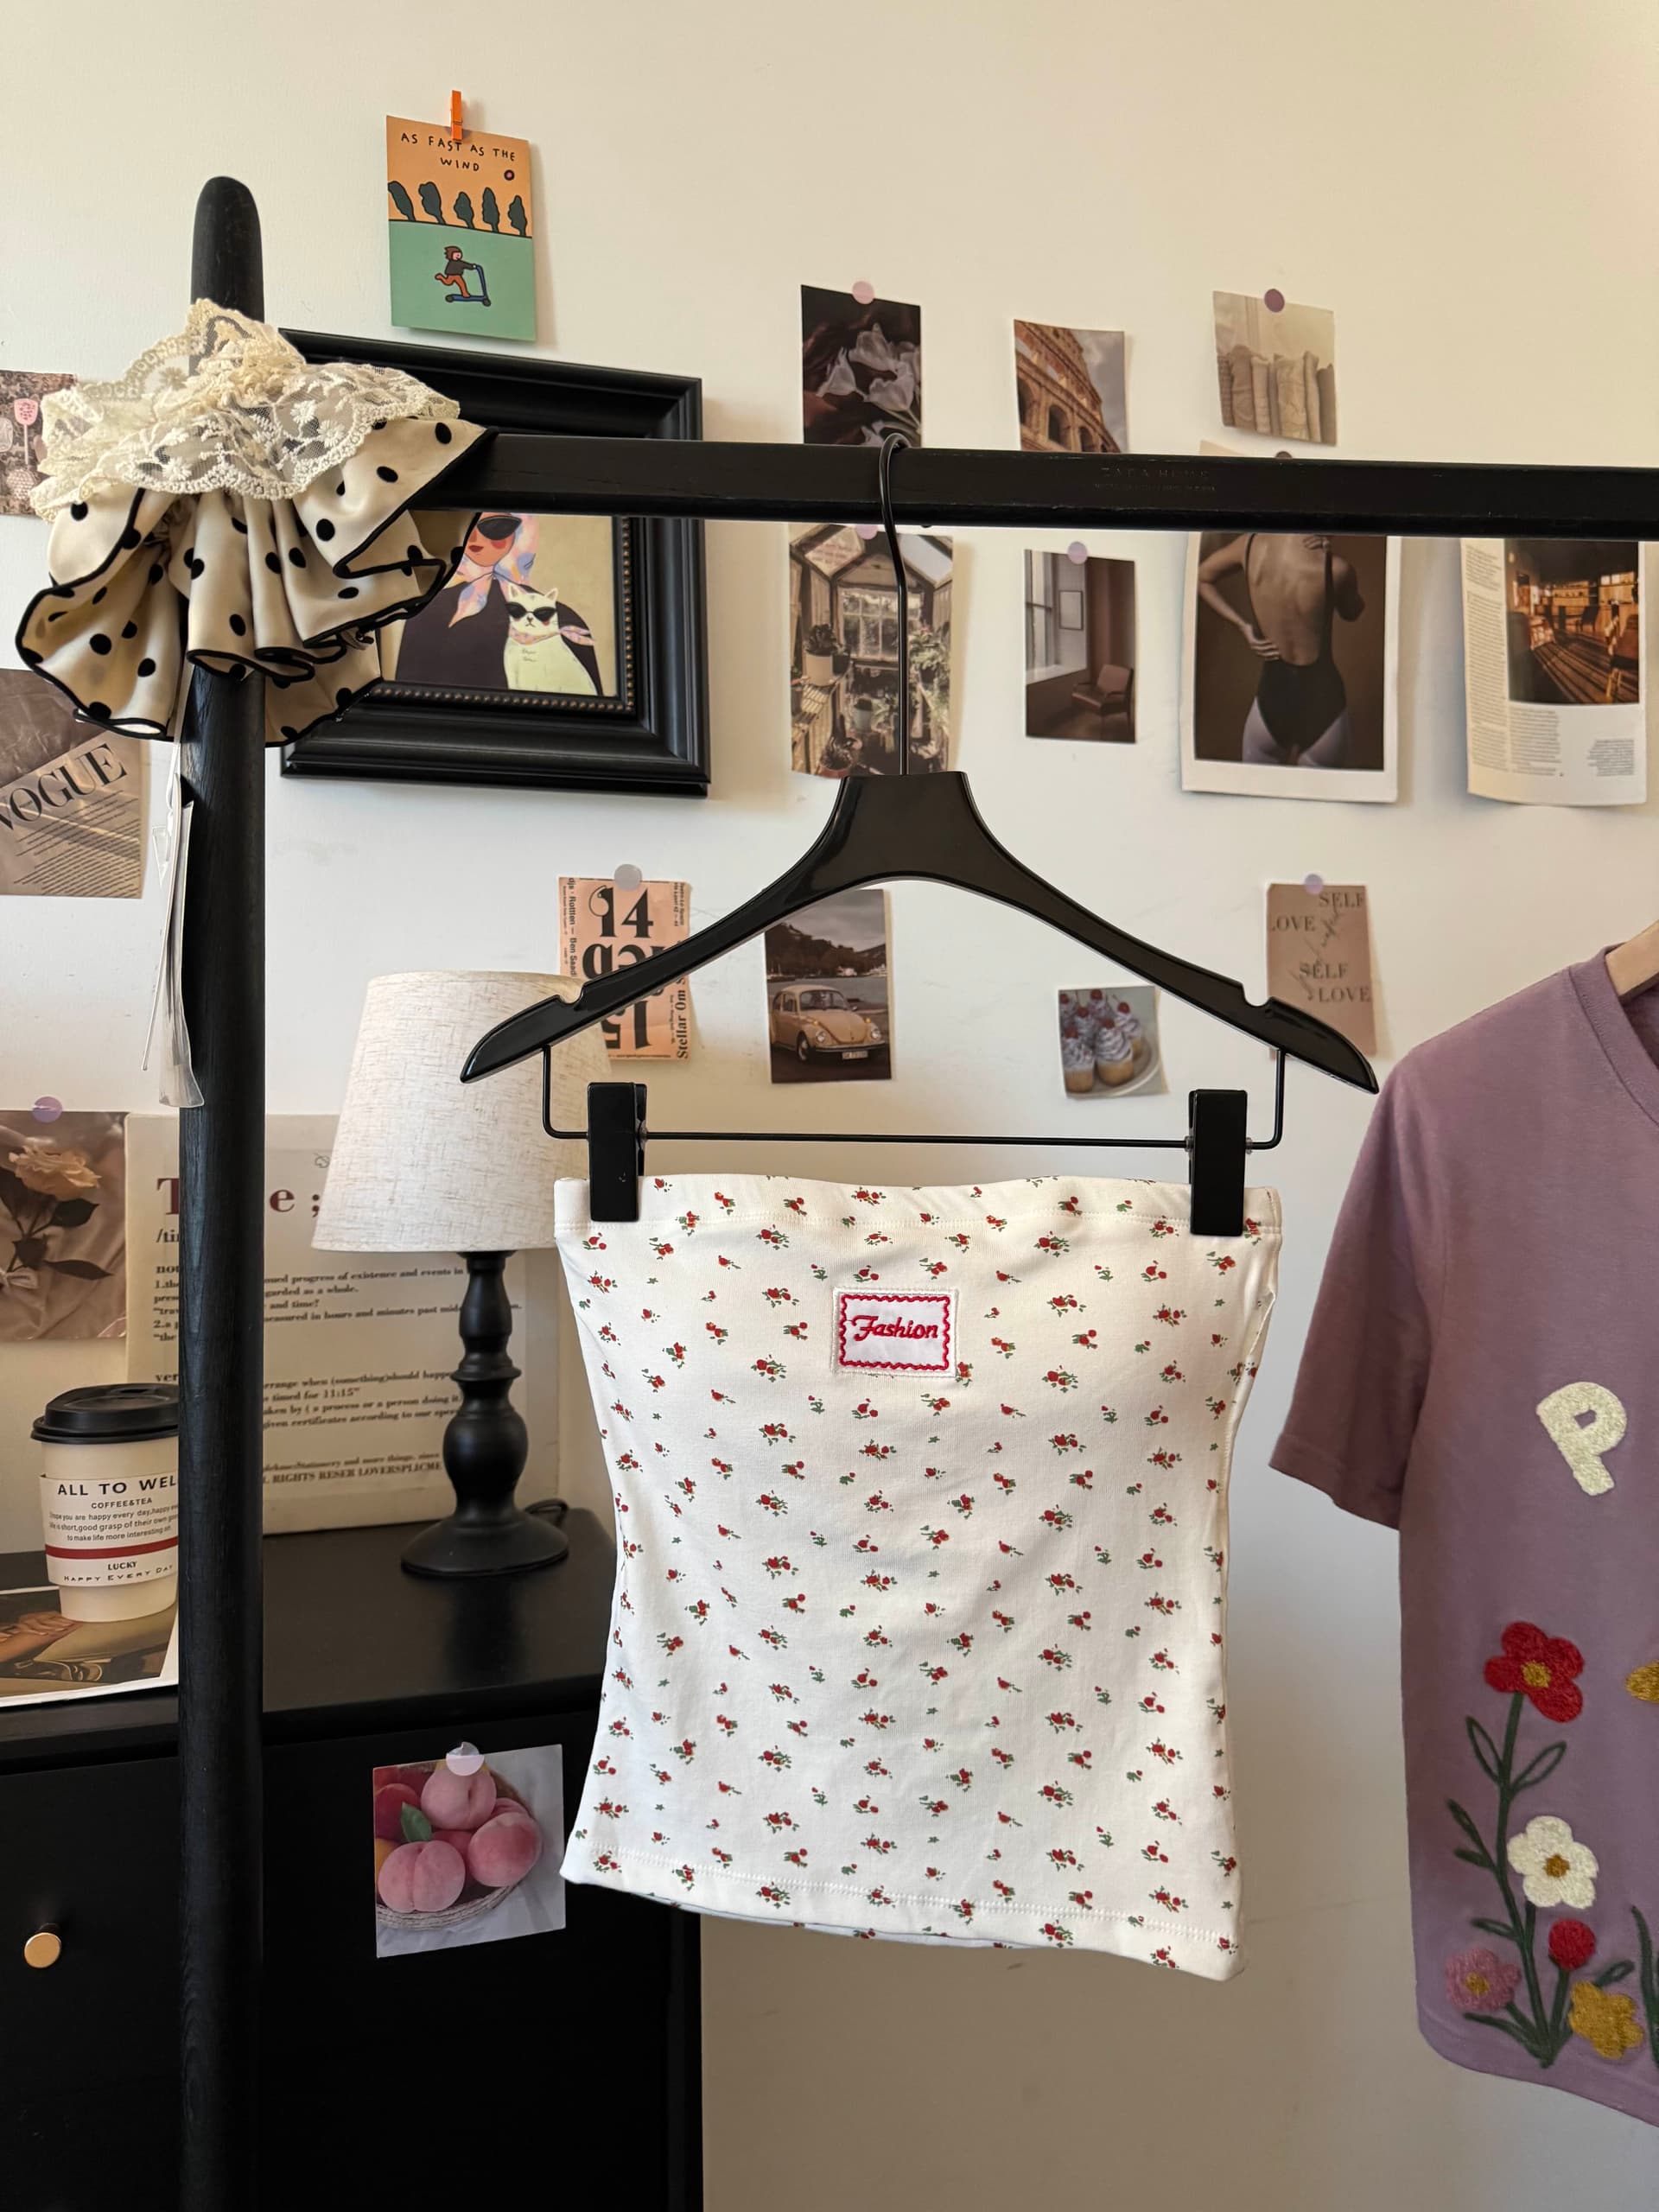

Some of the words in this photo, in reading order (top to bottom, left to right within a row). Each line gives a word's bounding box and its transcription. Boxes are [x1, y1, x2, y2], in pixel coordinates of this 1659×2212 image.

[401, 132, 418, 144] AS
[429, 136, 462, 152] FAST
[470, 144, 485, 156] AS
[493, 148, 516, 162] THE
[440, 157, 480, 171] WIND
[1319, 892, 1364, 907] SELF
[1271, 916, 1316, 931] OVE
[1300, 963, 1348, 979] SELF
[1319, 988, 1370, 1002] LOVE
[677, 1015, 688, 1059] Stellar
[291, 1275, 334, 1285] progress
[338, 1271, 349, 1281] of
[399, 1268, 418, 1277] and
[454, 1267, 464, 1275] in
[270, 1300, 289, 1310] and
[311, 1312, 321, 1320] in
[355, 1307, 373, 1318] and
[851, 1314, 938, 1341] Fashion
[302, 1377, 328, 1387] when
[304, 1389, 319, 1400] for
[290, 1404, 302, 1416] by
[1535, 1382, 1627, 1496] P
[58, 1484, 88, 1496] ALL
[99, 1482, 127, 1495] TO
[92, 1497, 152, 1510] COFFEE&TEA
[112, 1510, 134, 1520] every
[99, 1522, 122, 1534] grasp
[124, 1520, 134, 1529] of
[134, 1518, 152, 1528] their
[105, 1532, 125, 1541] more
[107, 1561, 138, 1571] LUCKY
[107, 1571, 150, 1581] EVERY
